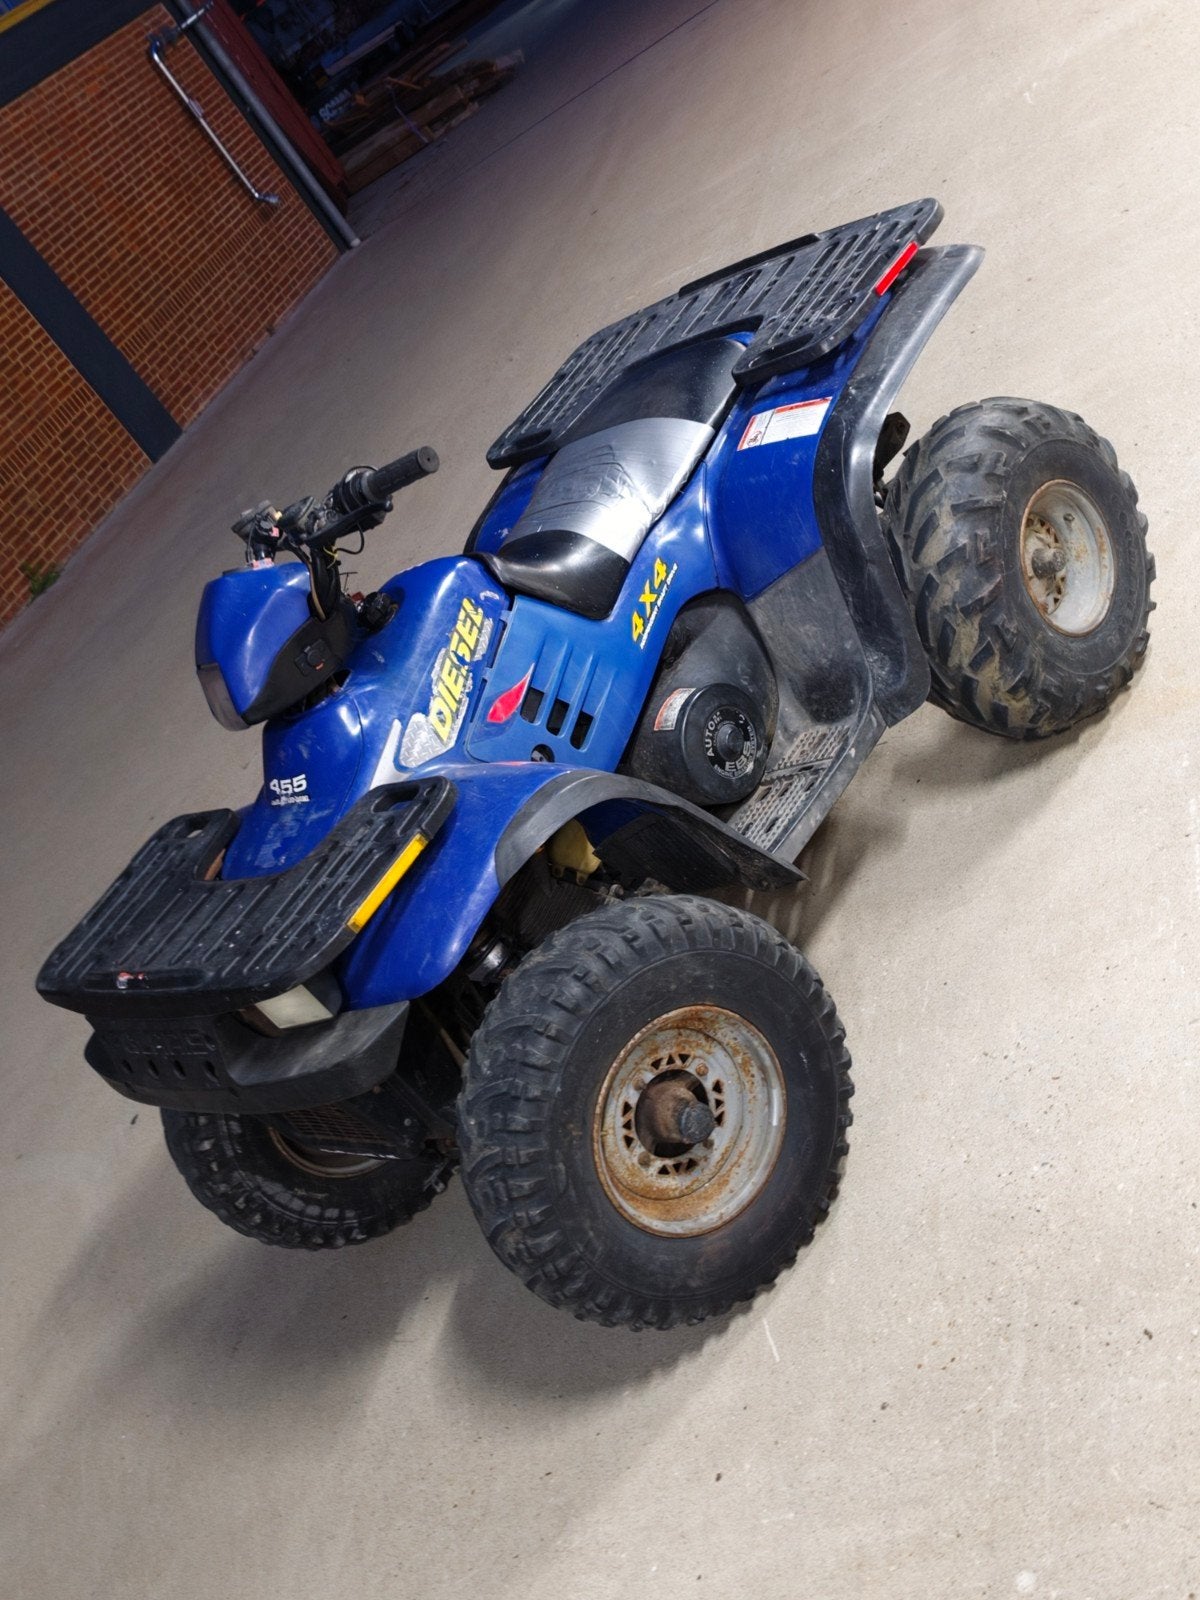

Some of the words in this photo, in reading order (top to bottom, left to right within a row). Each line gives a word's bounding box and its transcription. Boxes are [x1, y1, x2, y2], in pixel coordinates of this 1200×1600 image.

[631, 557, 667, 643] 4X4
[428, 597, 484, 743] DIESEL
[269, 773, 308, 795] 455
